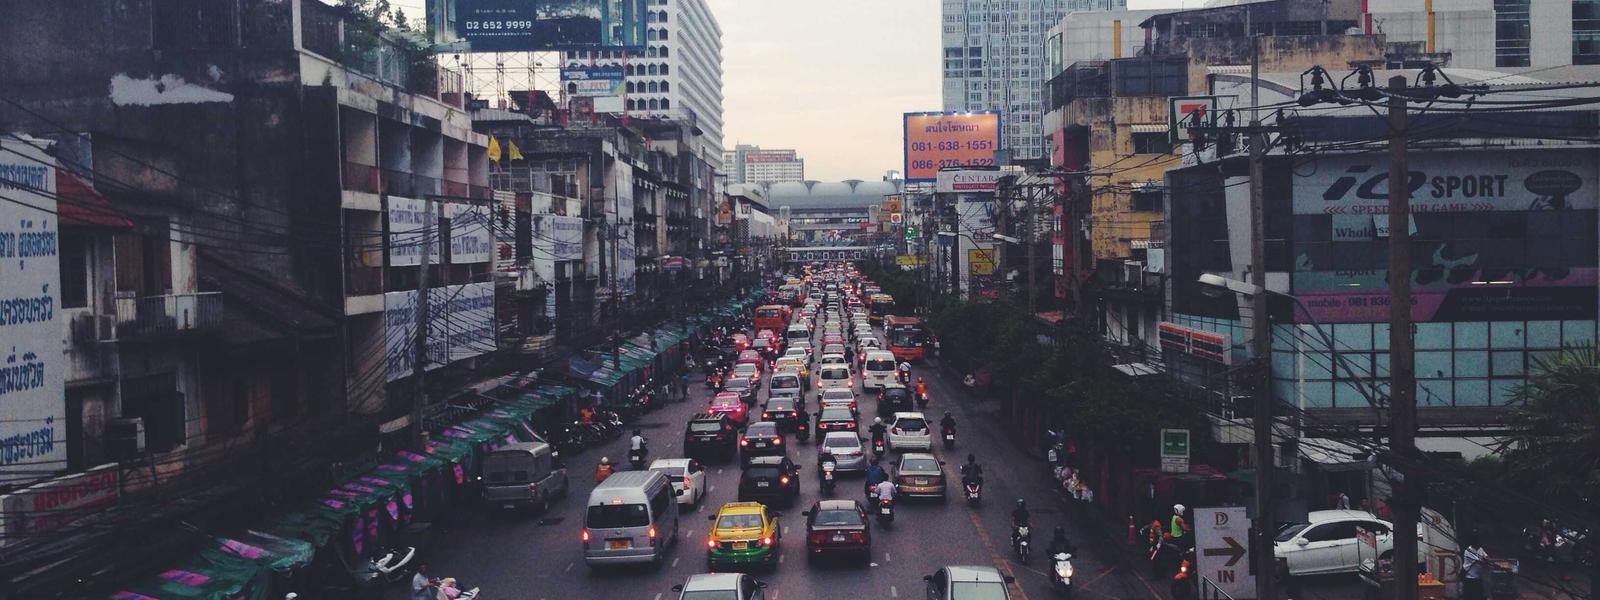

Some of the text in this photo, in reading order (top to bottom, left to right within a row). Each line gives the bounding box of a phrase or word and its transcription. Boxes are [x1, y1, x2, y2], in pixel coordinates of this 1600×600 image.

[466, 21, 532, 29] 02 652 9999
[925, 121, 979, 134] สนใจโฆษณา
[911, 140, 992, 151] 081-638-1551
[912, 158, 994, 169] 086-376-1522
[1431, 174, 1509, 198] SPORT
[1351, 205, 1390, 215] SPEED
[1432, 204, 1468, 213] GAME
[1217, 570, 1235, 583] IN
